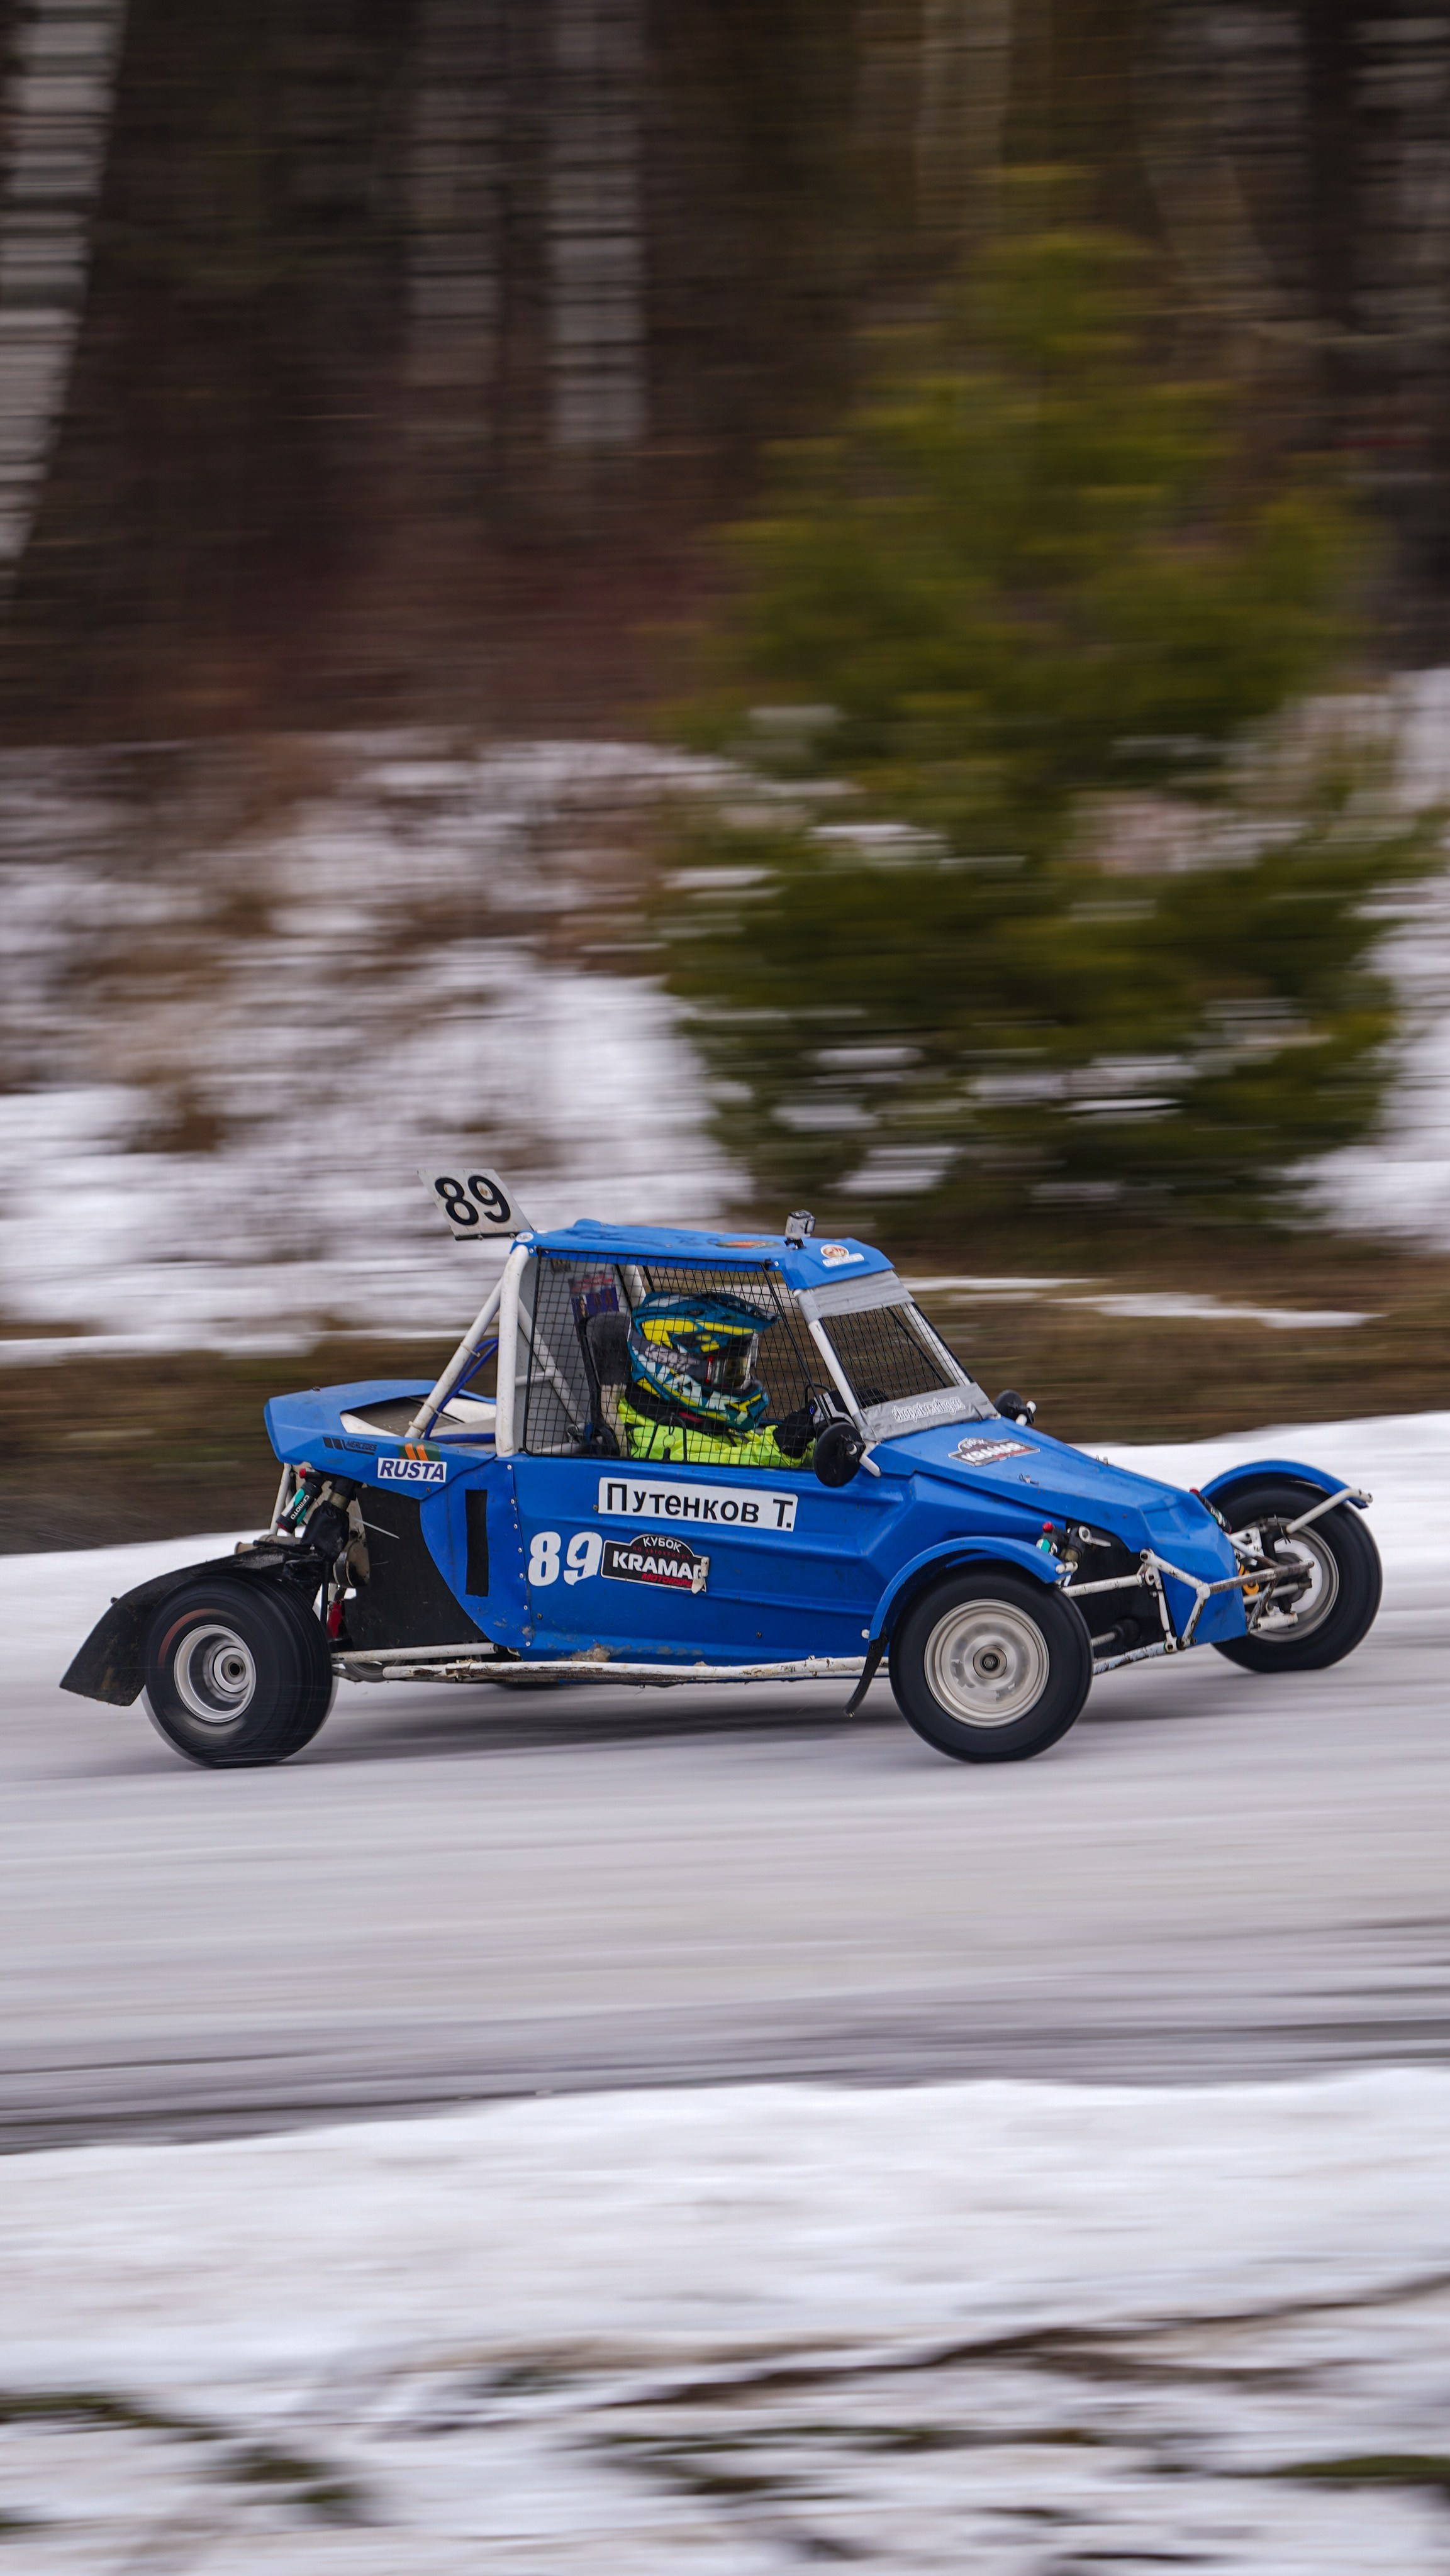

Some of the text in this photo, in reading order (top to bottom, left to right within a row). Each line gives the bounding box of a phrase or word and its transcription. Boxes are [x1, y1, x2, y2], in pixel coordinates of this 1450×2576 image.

[435, 1176, 510, 1225] 89
[379, 1460, 444, 1480] RUSTA
[290, 1494, 310, 1520] CFMOTO
[607, 1482, 793, 1528] Путенков Т.
[643, 1536, 681, 1553] КУБОК
[528, 1531, 603, 1586] 89
[642, 1572, 693, 1588] MOTORSPO
